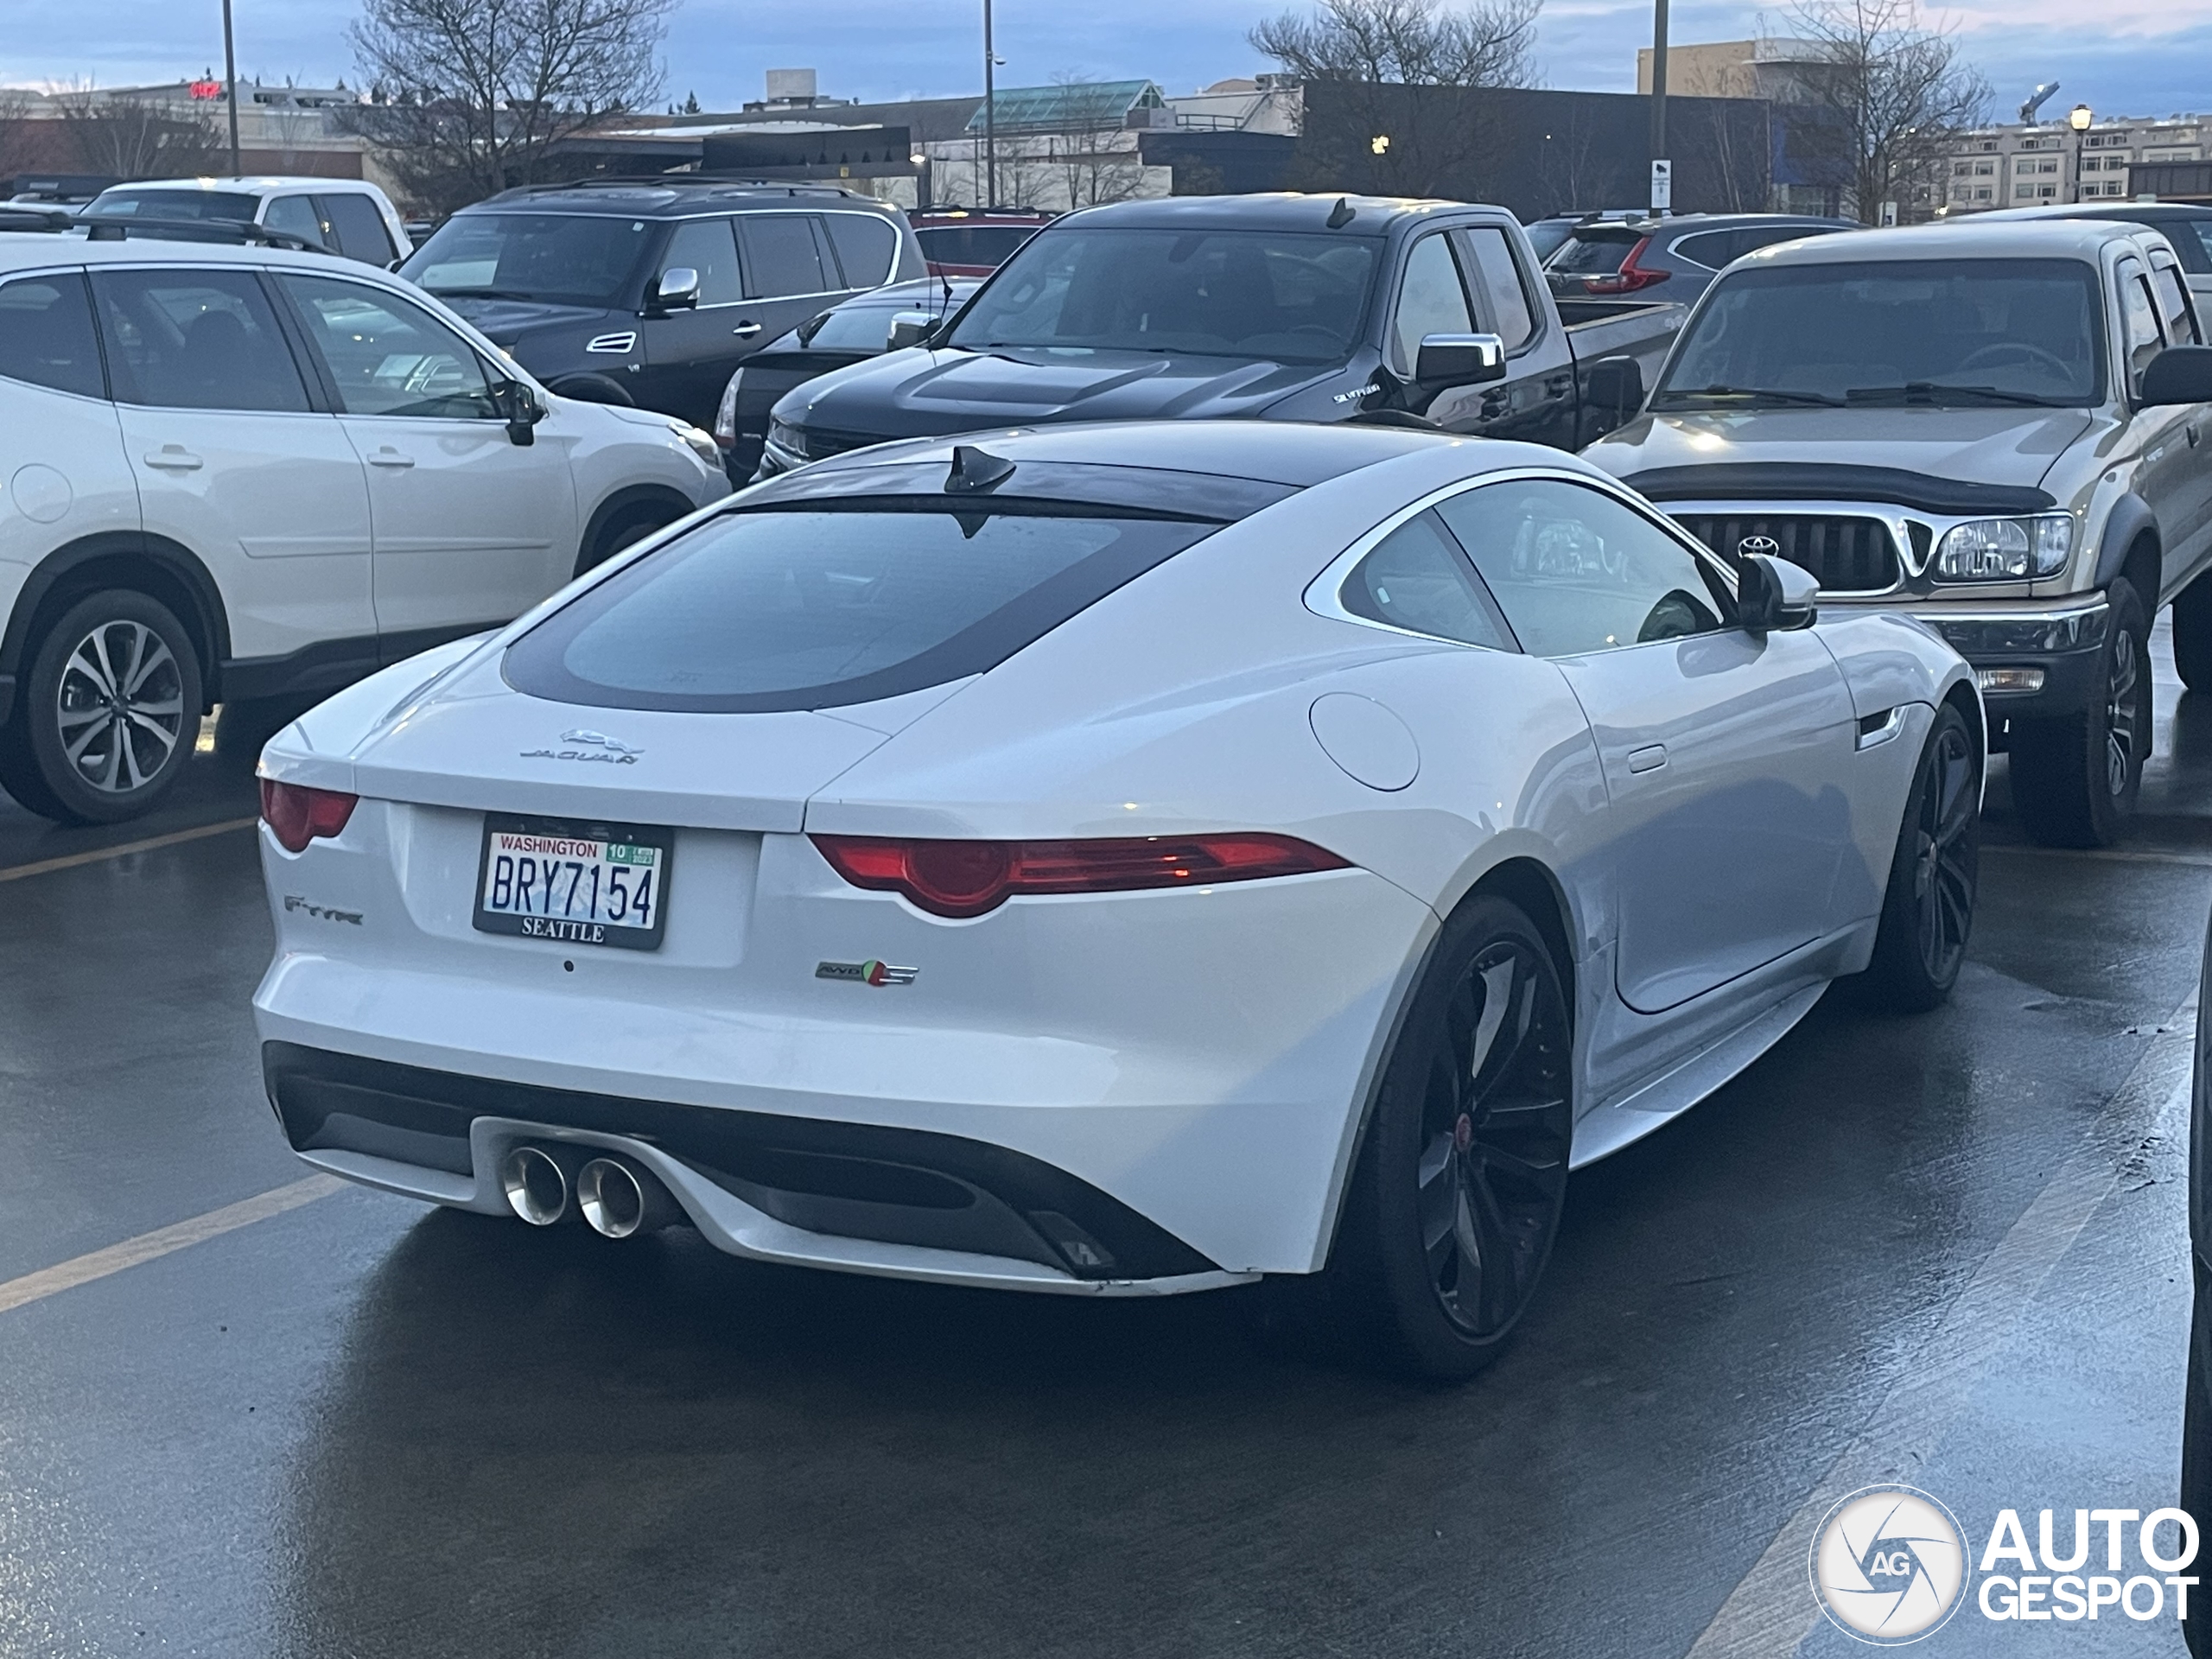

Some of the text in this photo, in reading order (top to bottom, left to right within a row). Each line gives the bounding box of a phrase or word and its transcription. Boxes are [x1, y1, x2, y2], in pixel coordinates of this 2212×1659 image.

[519, 749, 639, 765] JAGUAR
[500, 835, 598, 858] WASHINGTON
[609, 843, 626, 858] 10
[492, 855, 652, 925] BRY7154
[521, 917, 605, 943] SEATTLE
